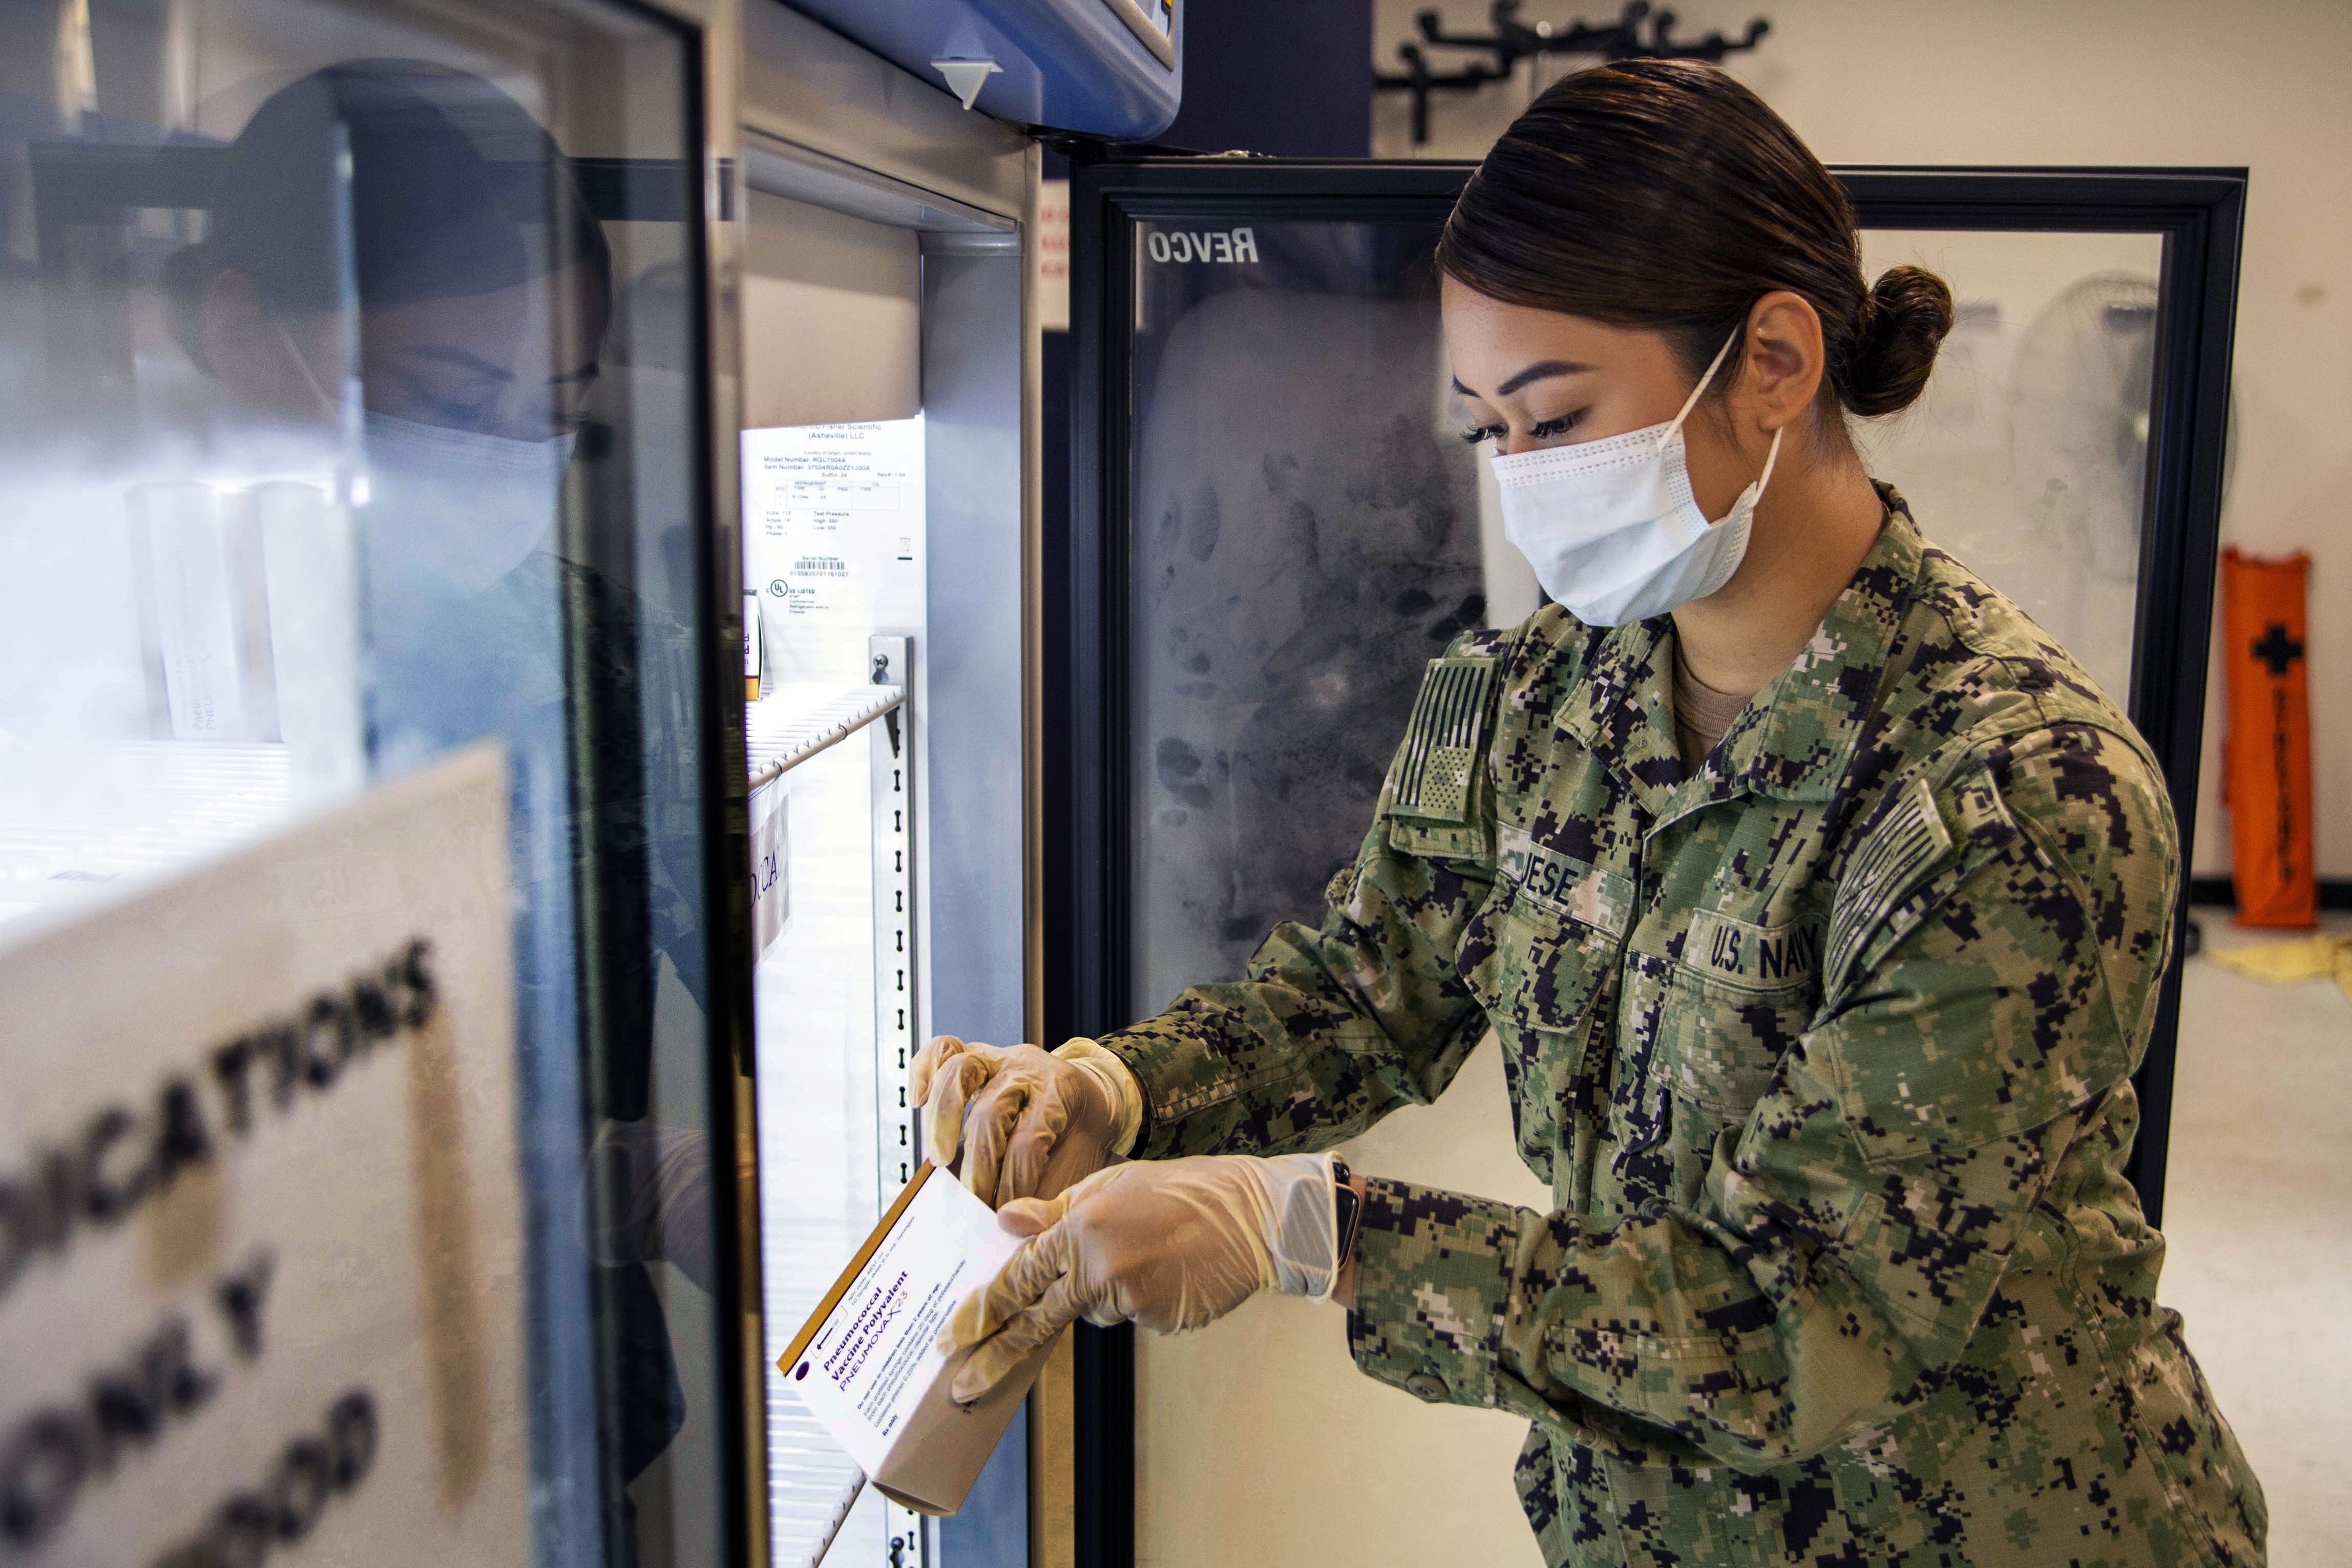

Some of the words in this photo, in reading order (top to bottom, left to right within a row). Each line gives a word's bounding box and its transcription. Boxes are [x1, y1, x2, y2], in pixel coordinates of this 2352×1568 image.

[1711, 925, 1743, 974] U.S.
[1759, 923, 1818, 979] NAVY
[824, 1287, 881, 1371] Pneumococcal
[832, 1337, 864, 1380] Vaccine
[863, 1272, 908, 1335] Polyvalent
[839, 1306, 901, 1391] PNEUMOVAX
